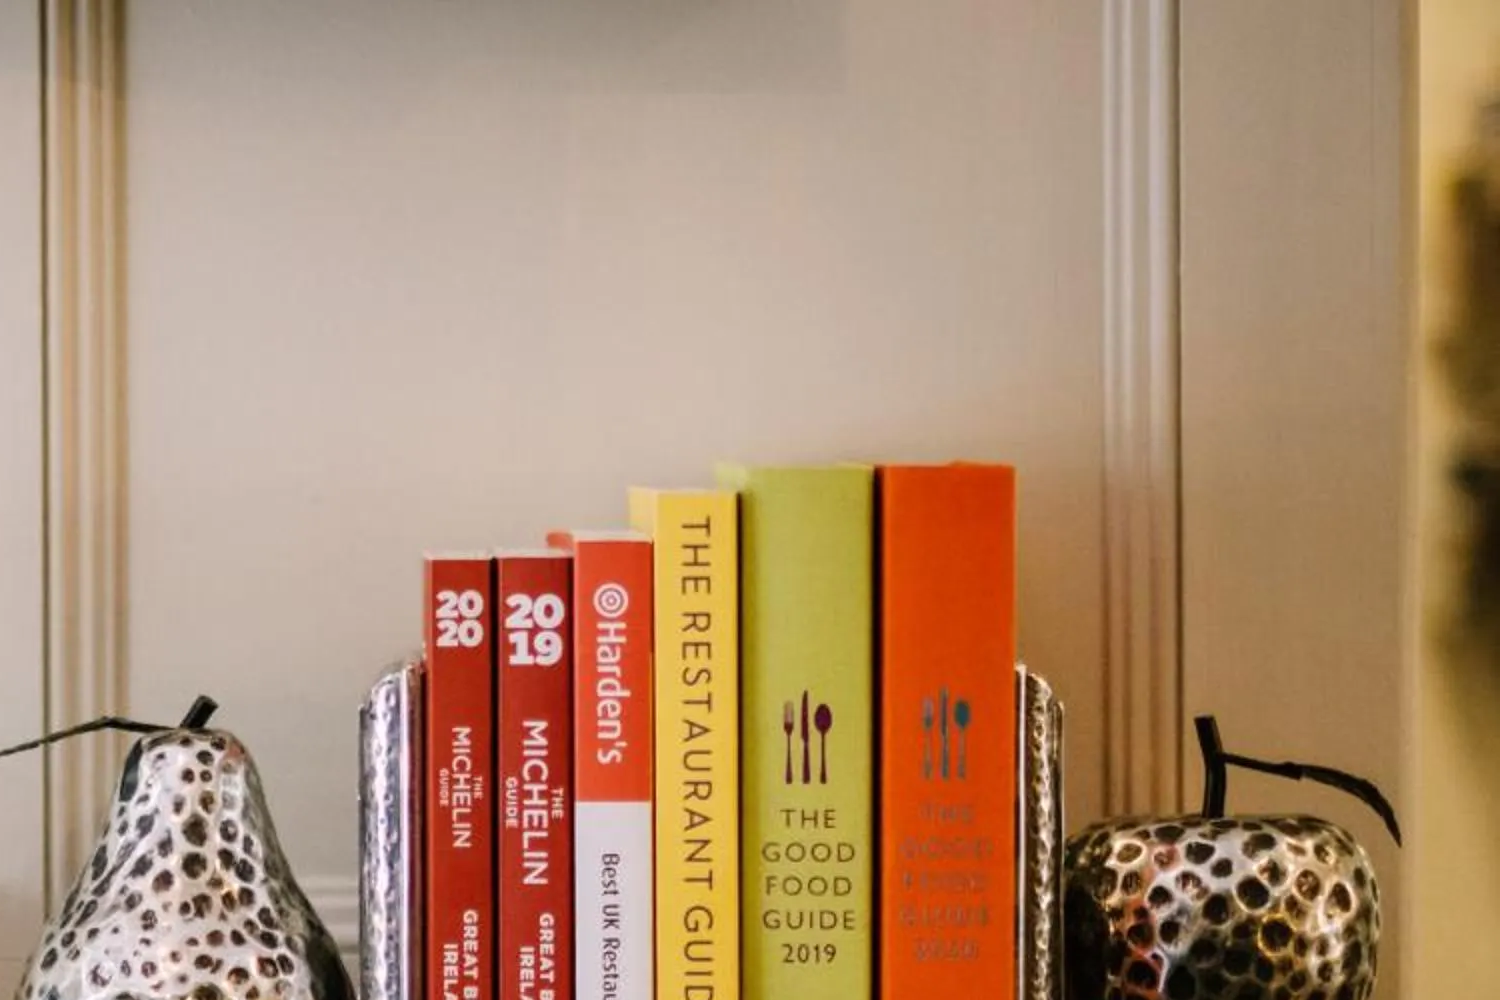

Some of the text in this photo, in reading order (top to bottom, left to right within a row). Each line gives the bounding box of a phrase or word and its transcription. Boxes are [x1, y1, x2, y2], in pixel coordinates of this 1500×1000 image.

[681, 516, 711, 595] THE
[436, 589, 484, 619] 20
[504, 593, 565, 629] 20
[436, 619, 484, 647] 20
[508, 629, 563, 666] 19
[596, 621, 632, 766] Harden's
[681, 611, 713, 890] RESTAURANT
[452, 726, 472, 848] MICHELIN
[473, 775, 483, 800] THE
[505, 776, 518, 828] GUIDE
[522, 720, 549, 885] MICHELIN
[551, 787, 564, 819] THE
[780, 808, 837, 829] THE
[761, 842, 856, 863] GOOD
[601, 853, 621, 896] Best
[765, 876, 853, 897] FOOD
[601, 904, 621, 930] UK
[762, 909, 856, 930] GUIDE
[463, 909, 479, 979] GREAT
[539, 912, 555, 983] GREAT
[781, 943, 837, 963] 2019
